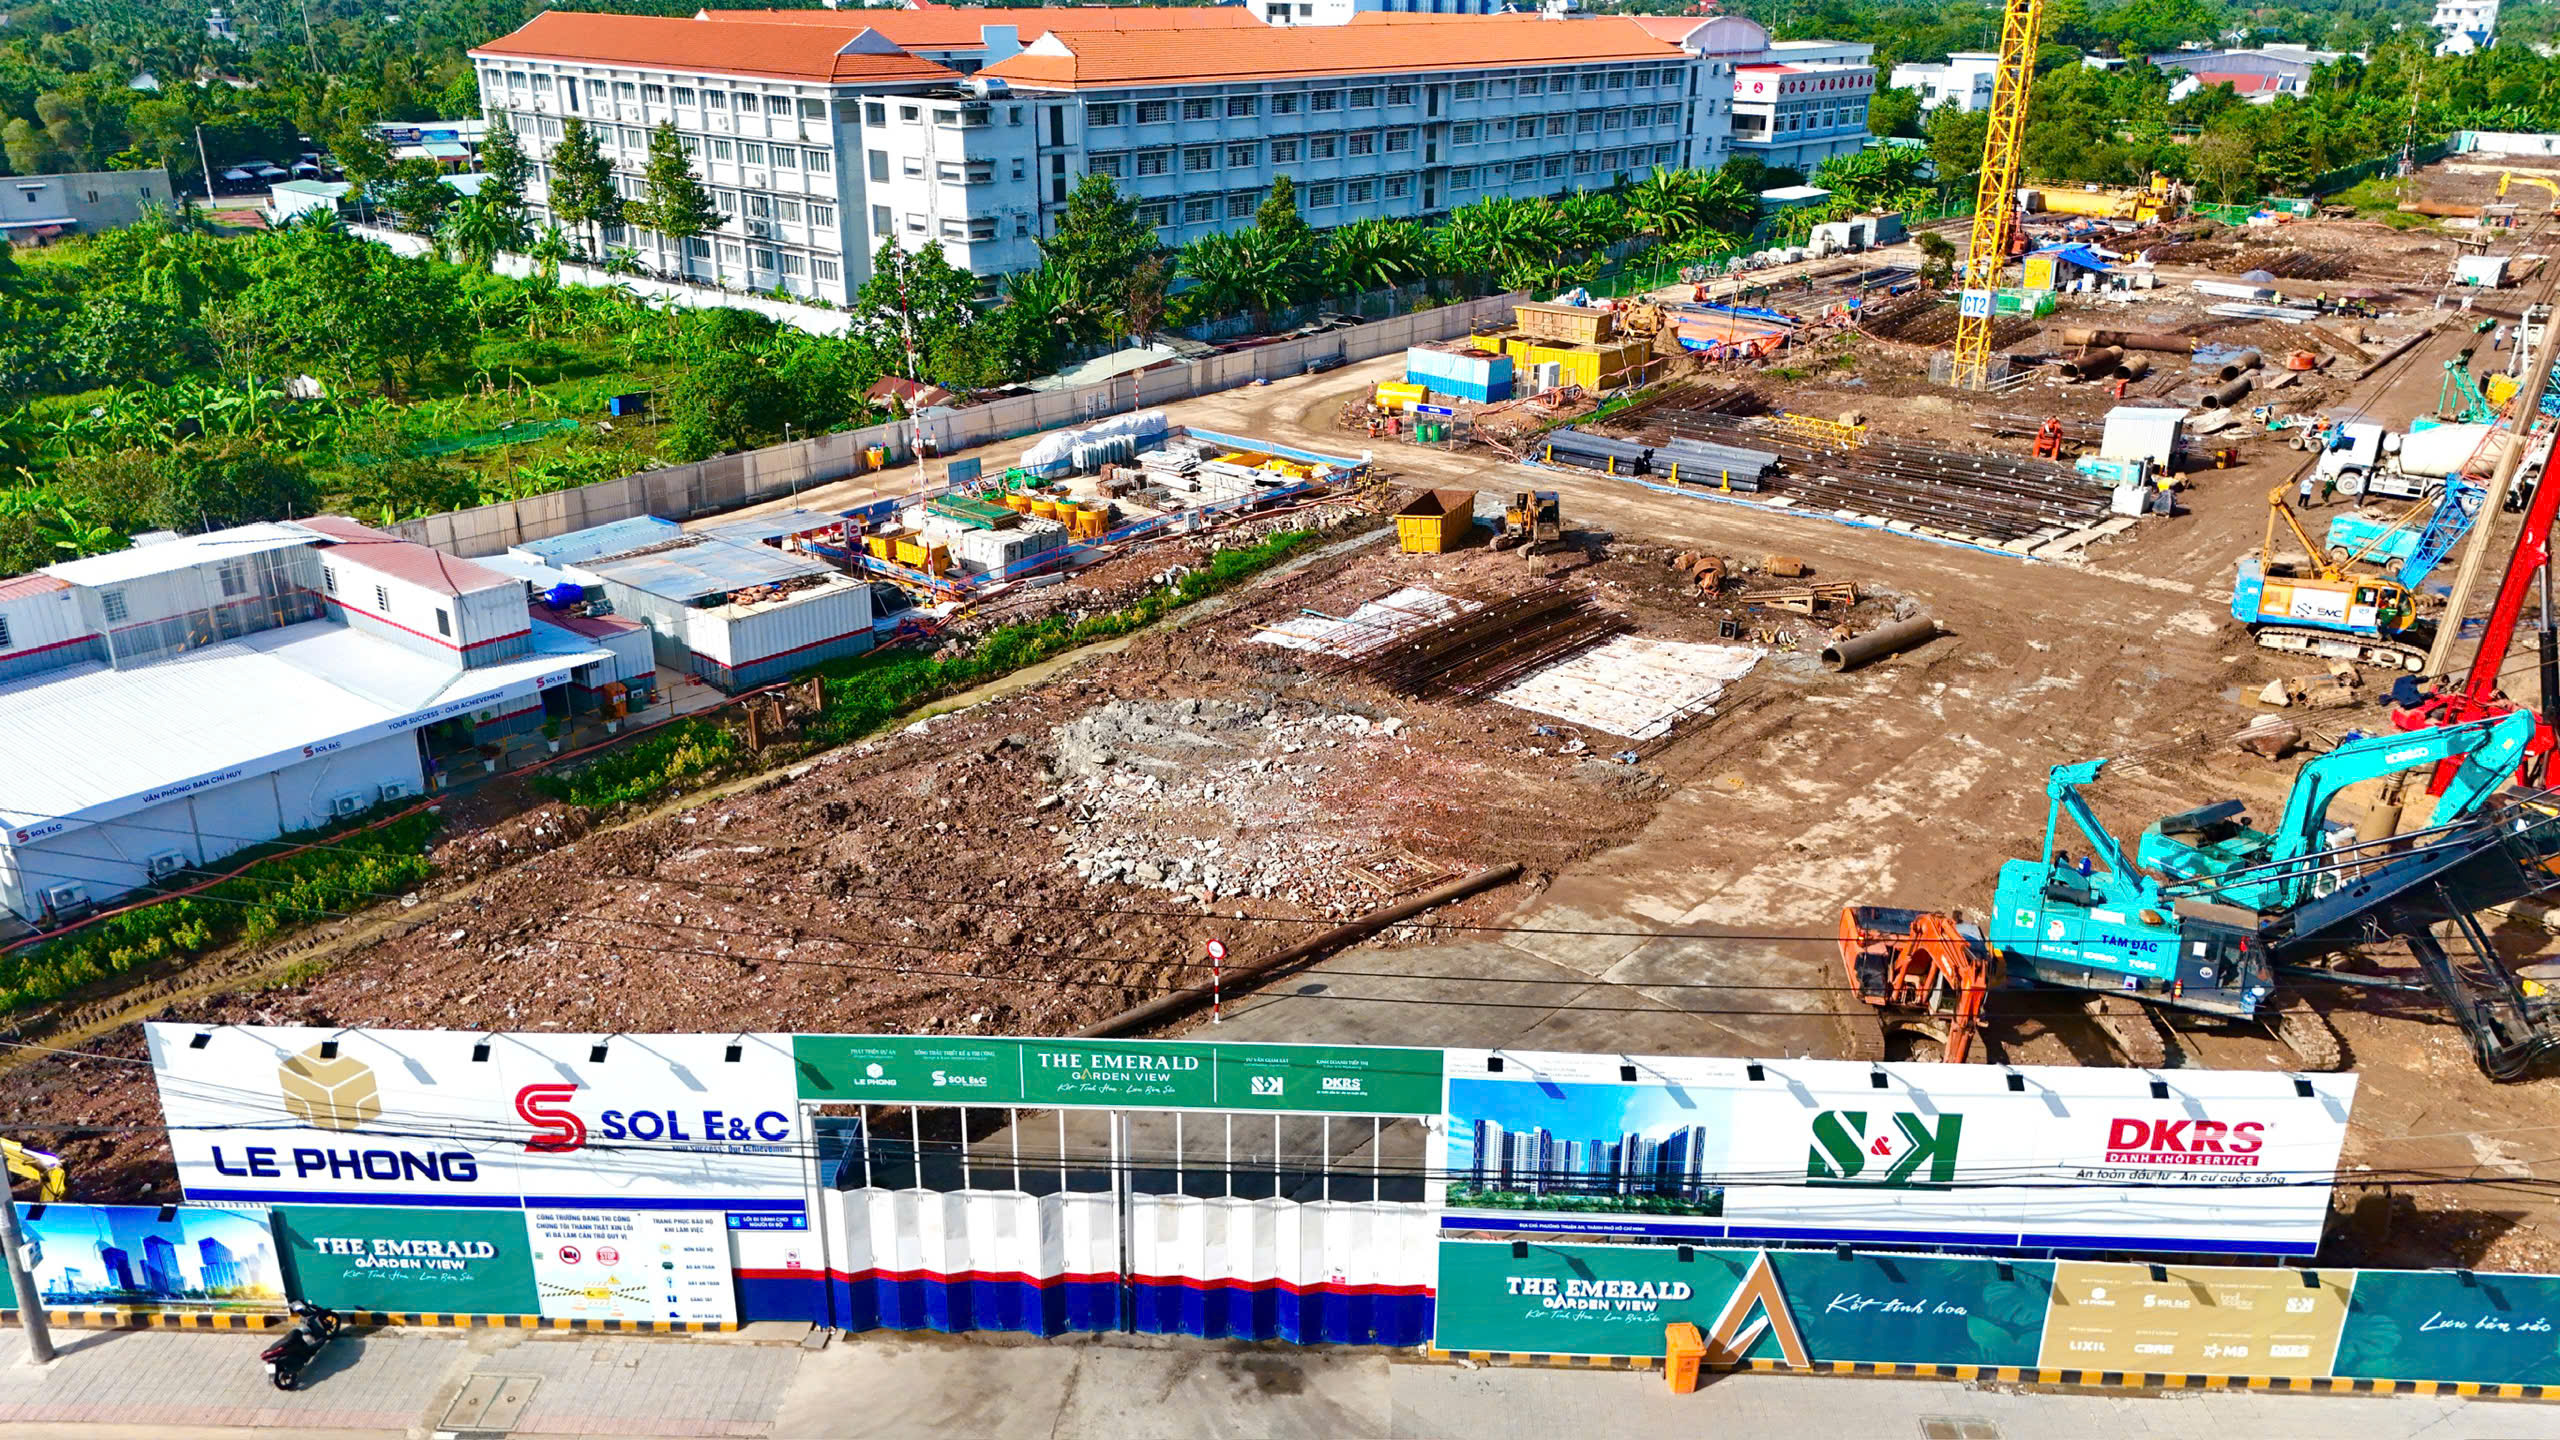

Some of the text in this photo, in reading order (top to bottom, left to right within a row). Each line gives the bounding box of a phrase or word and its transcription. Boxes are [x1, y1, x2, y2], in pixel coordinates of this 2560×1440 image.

[1964, 296, 1986, 314] CT2
[387, 691, 504, 731] YOUR SUCCESS OUR ACHIEVEMENT
[143, 792, 160, 803] VĂN
[161, 784, 191, 799] PHÒNG
[193, 779, 210, 789] BAN
[226, 769, 242, 780] HUY
[31, 823, 62, 837] SOL E&C
[1038, 1053, 1199, 1070] THE EMERALD
[854, 1078, 866, 1086] LE
[949, 1076, 987, 1084] SOL E&C
[1071, 1068, 1170, 1082] GARDEN VIEW
[1322, 1077, 1360, 1088] DKRS
[601, 1110, 690, 1141] SOL
[703, 1110, 790, 1142] E&C
[2107, 1118, 2264, 1153] DKRS
[211, 1146, 478, 1182] LE PHONG
[2110, 1152, 2253, 1166] DANH KHÔI SERVICE
[2076, 1169, 2093, 1178] An
[2097, 1168, 2125, 1179] toàn
[2180, 1171, 2196, 1181] An
[2201, 1173, 2216, 1182] cư
[314, 1237, 496, 1259] THE EMERALD
[600, 1252, 616, 1260] STOP
[355, 1253, 466, 1270] GARDEN VIEW
[1507, 1277, 1692, 1300] THE EMERALD
[1543, 1294, 1657, 1312] GARDEN VIEW
[1825, 1293, 1882, 1314] Kết
[1932, 1301, 1968, 1315] hoa
[2069, 1341, 2106, 1352] LIXIL
[2134, 1344, 2174, 1355] CBRE
[2223, 1345, 2249, 1358] MB
